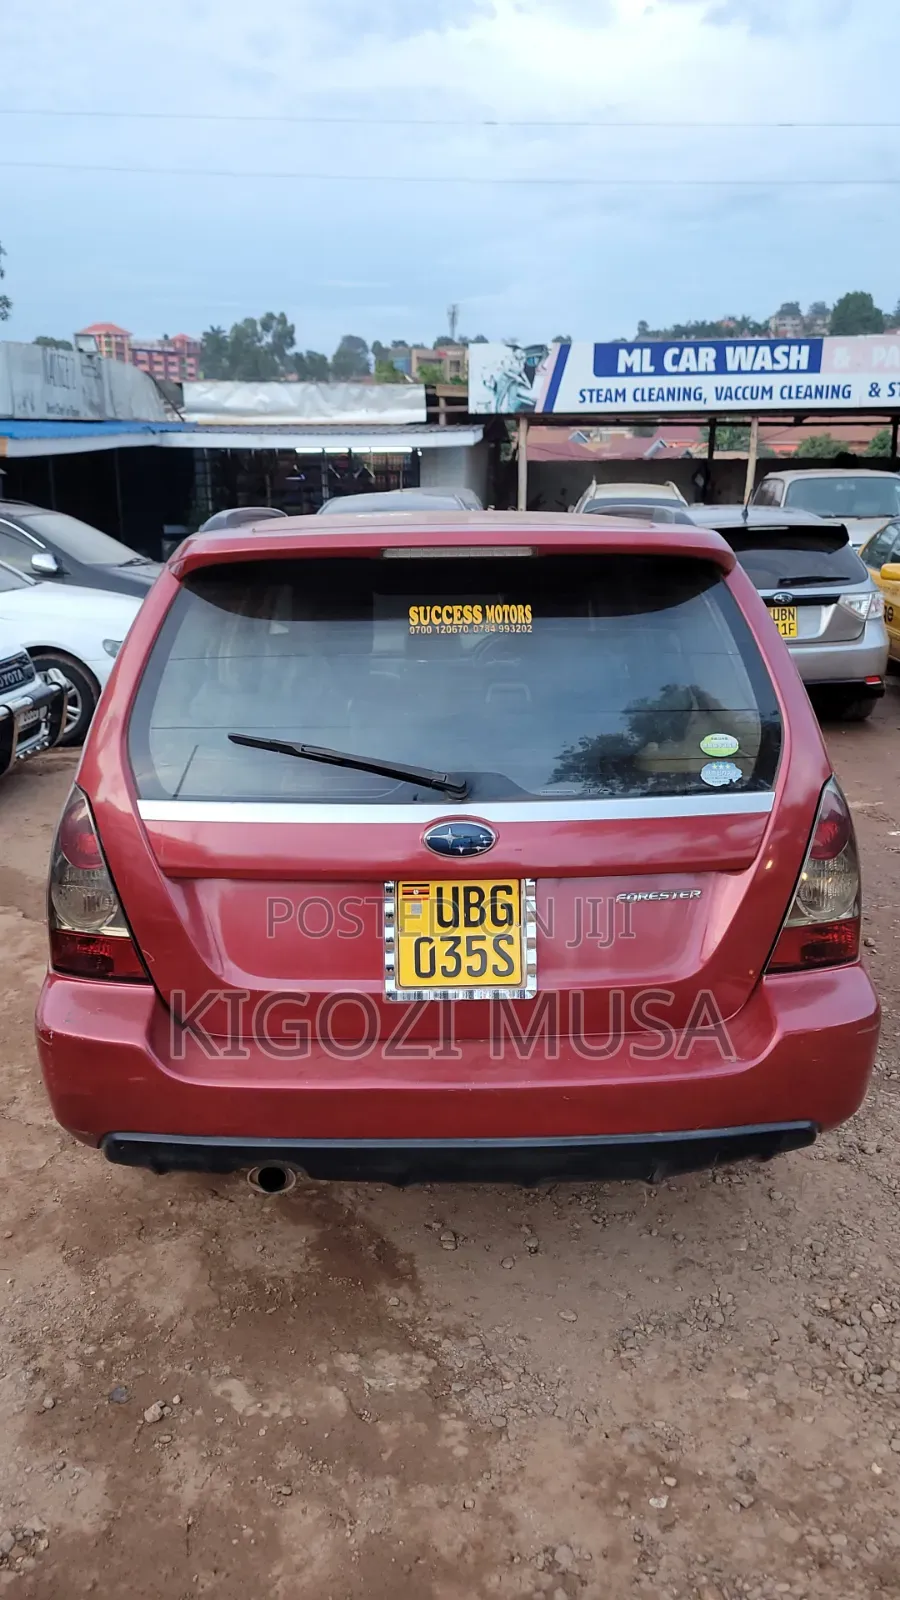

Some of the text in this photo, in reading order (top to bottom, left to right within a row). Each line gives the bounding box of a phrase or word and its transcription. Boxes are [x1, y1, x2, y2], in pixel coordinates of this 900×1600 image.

[617, 348, 655, 373] ML
[663, 347, 717, 373] CAR
[725, 344, 810, 371] WASH
[579, 388, 626, 403] STEAM
[632, 386, 707, 404] CLEANING,
[715, 385, 773, 401] VACCUM
[780, 384, 852, 400] CLEANING
[868, 382, 881, 397] &
[409, 605, 532, 625] SUCCESS MOTORS
[773, 608, 795, 621] UBN
[409, 625, 432, 634] 0700
[436, 885, 514, 928] UBG
[615, 889, 702, 903] FORESTER
[414, 934, 515, 978] 035S
